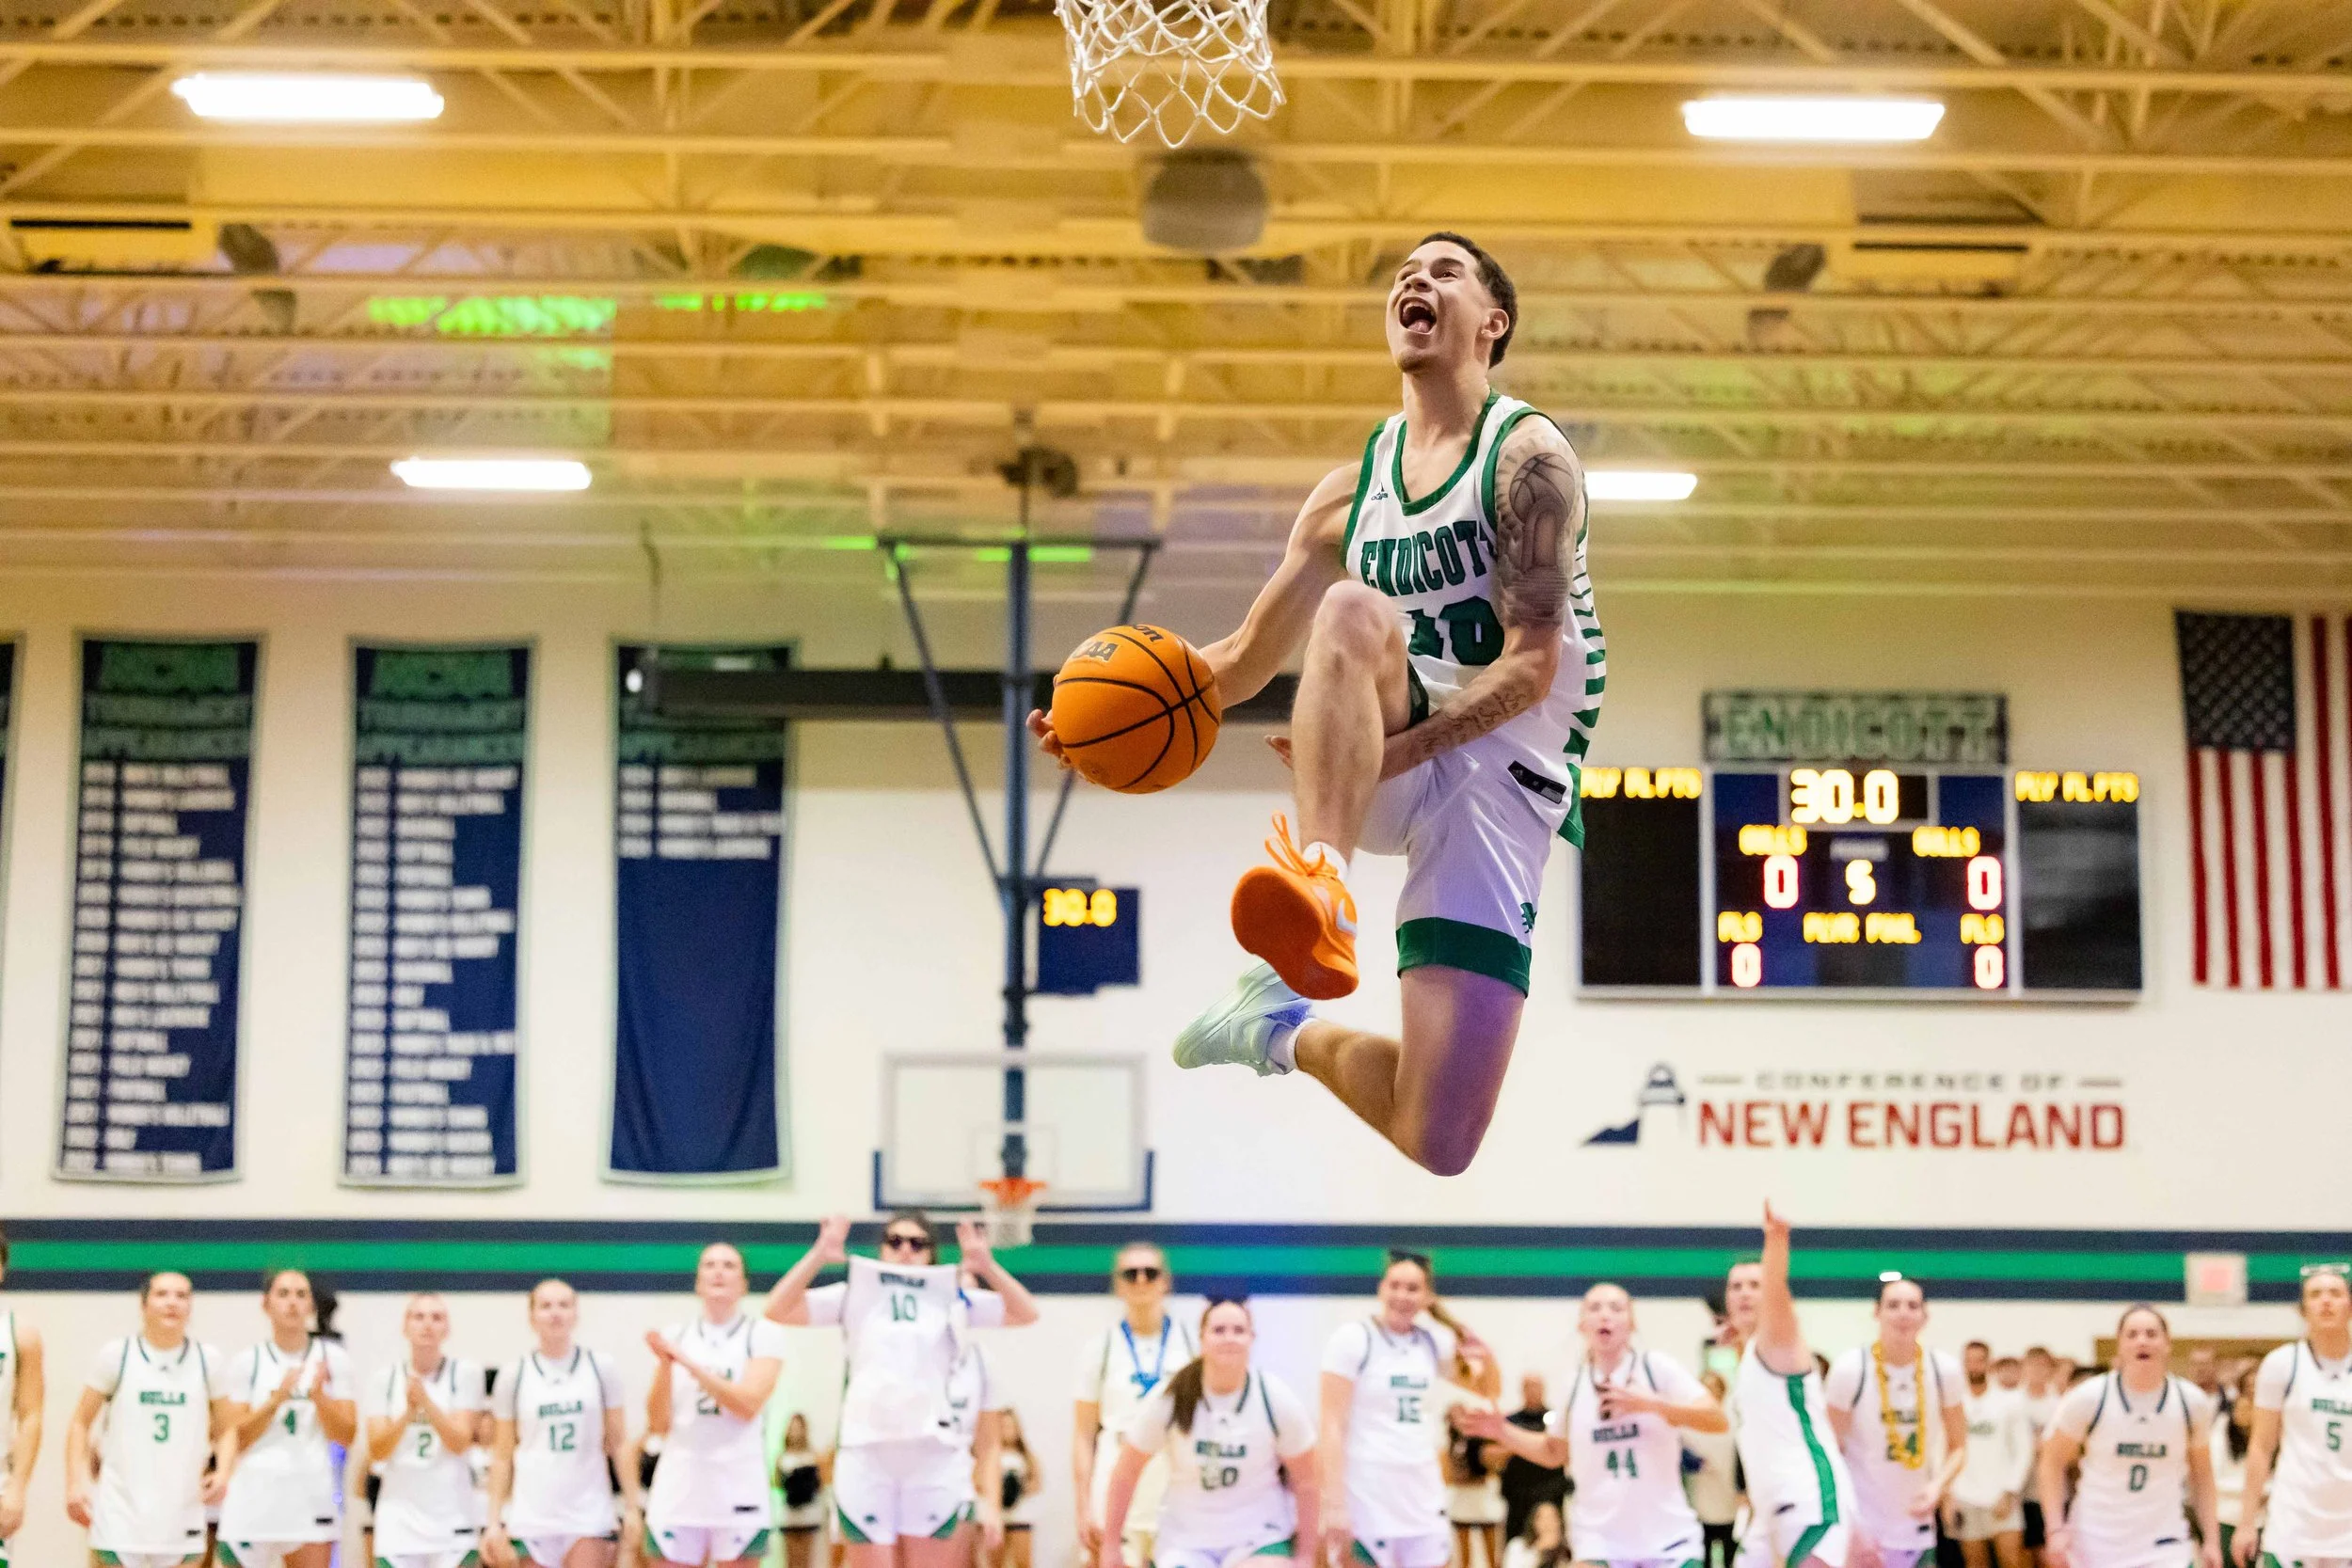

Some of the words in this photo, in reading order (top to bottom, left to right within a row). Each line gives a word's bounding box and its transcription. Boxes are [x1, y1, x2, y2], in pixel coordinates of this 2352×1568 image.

[1714, 701, 1994, 757] ENDICOTT
[1790, 768, 1899, 825] 30.0
[1764, 854, 1799, 909] 0
[1967, 856, 2002, 911] 0
[1732, 942, 1761, 988] 0
[1975, 944, 2004, 989] 0
[1756, 1072, 2004, 1091] CONFERENCE
[2020, 1074, 2063, 1092] OF
[1699, 1101, 1829, 1147] NEW
[1847, 1101, 2125, 1148] ENGLAND
[890, 1292, 918, 1323] 10
[153, 1414, 169, 1442] 3
[284, 1408, 296, 1435] 4
[548, 1422, 575, 1451] 12
[2326, 1420, 2342, 1453] 5
[417, 1432, 432, 1458] 2
[1606, 1448, 1639, 1481] 44
[2129, 1464, 2148, 1493] 0
